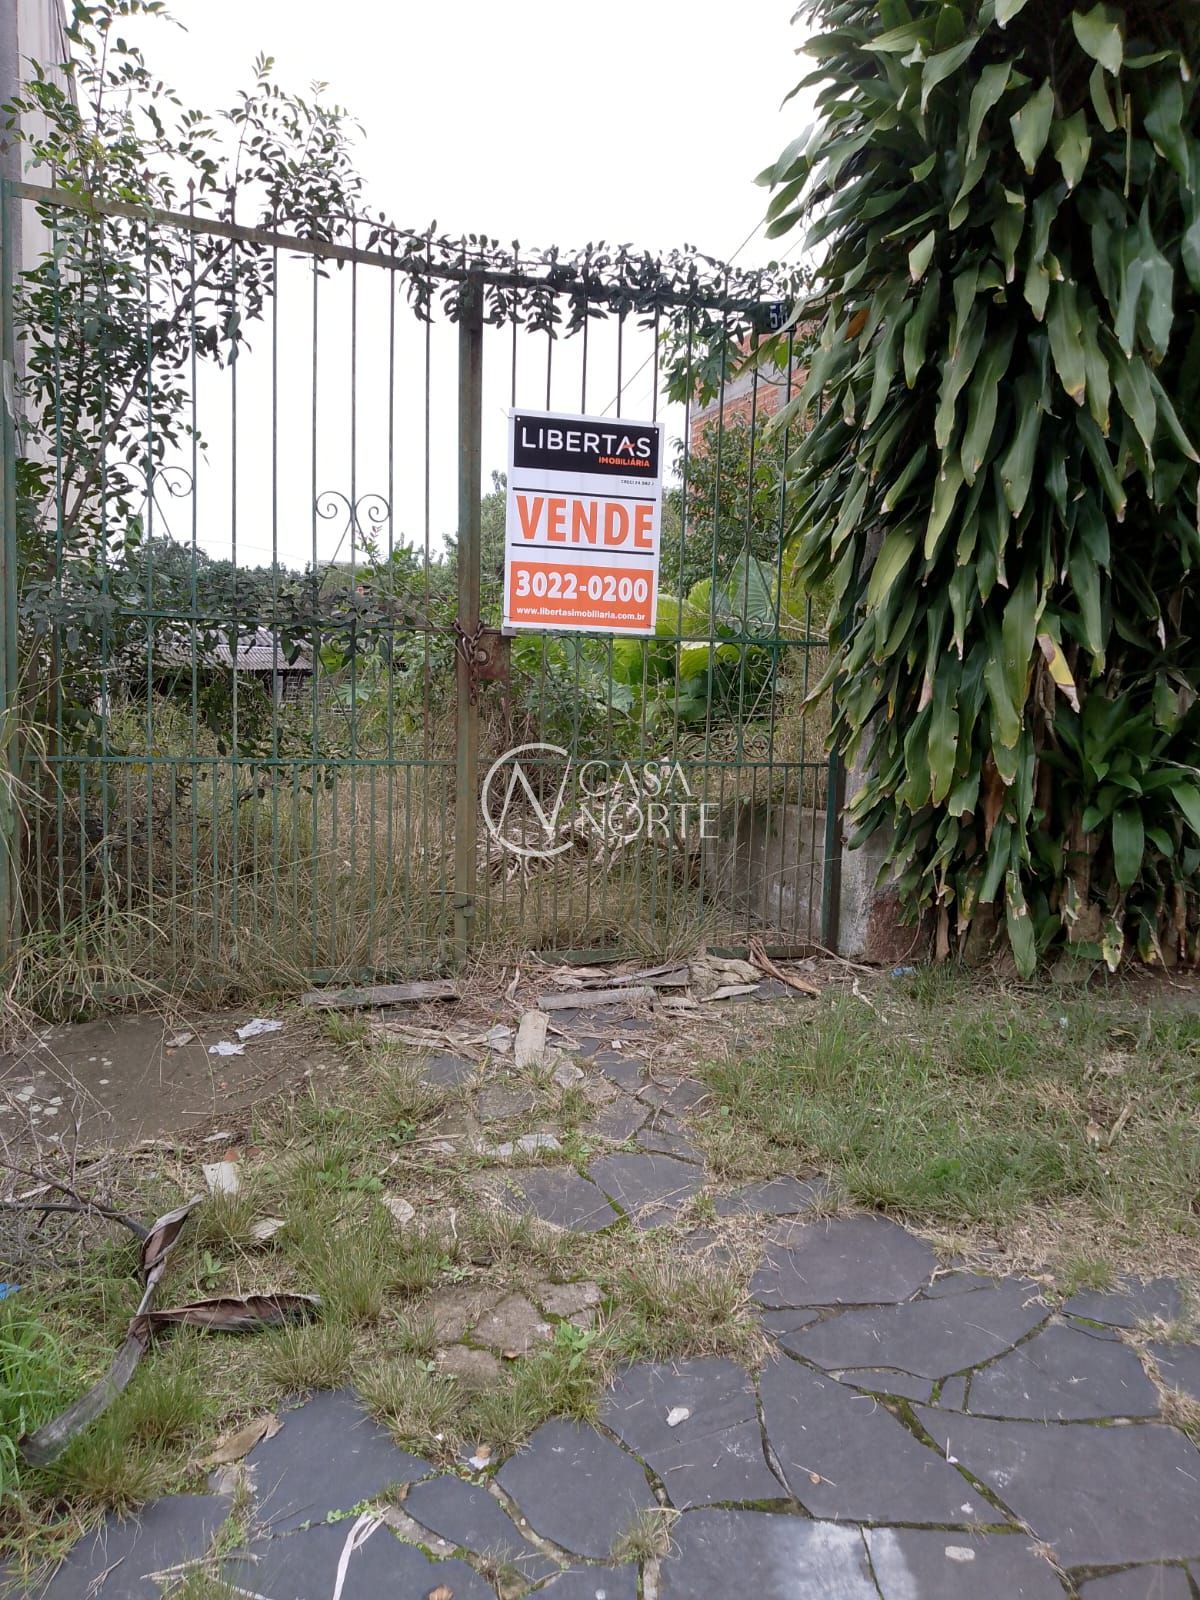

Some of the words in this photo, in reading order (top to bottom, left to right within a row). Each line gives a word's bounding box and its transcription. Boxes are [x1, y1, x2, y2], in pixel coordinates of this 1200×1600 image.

[522, 427, 651, 458] LIBERTAS
[598, 455, 651, 468] IMOBILIÁRIA
[516, 495, 654, 549] VENDE
[515, 569, 648, 603] 3022-0200
[516, 606, 646, 621] www.libertasimobiliaria.com.br
